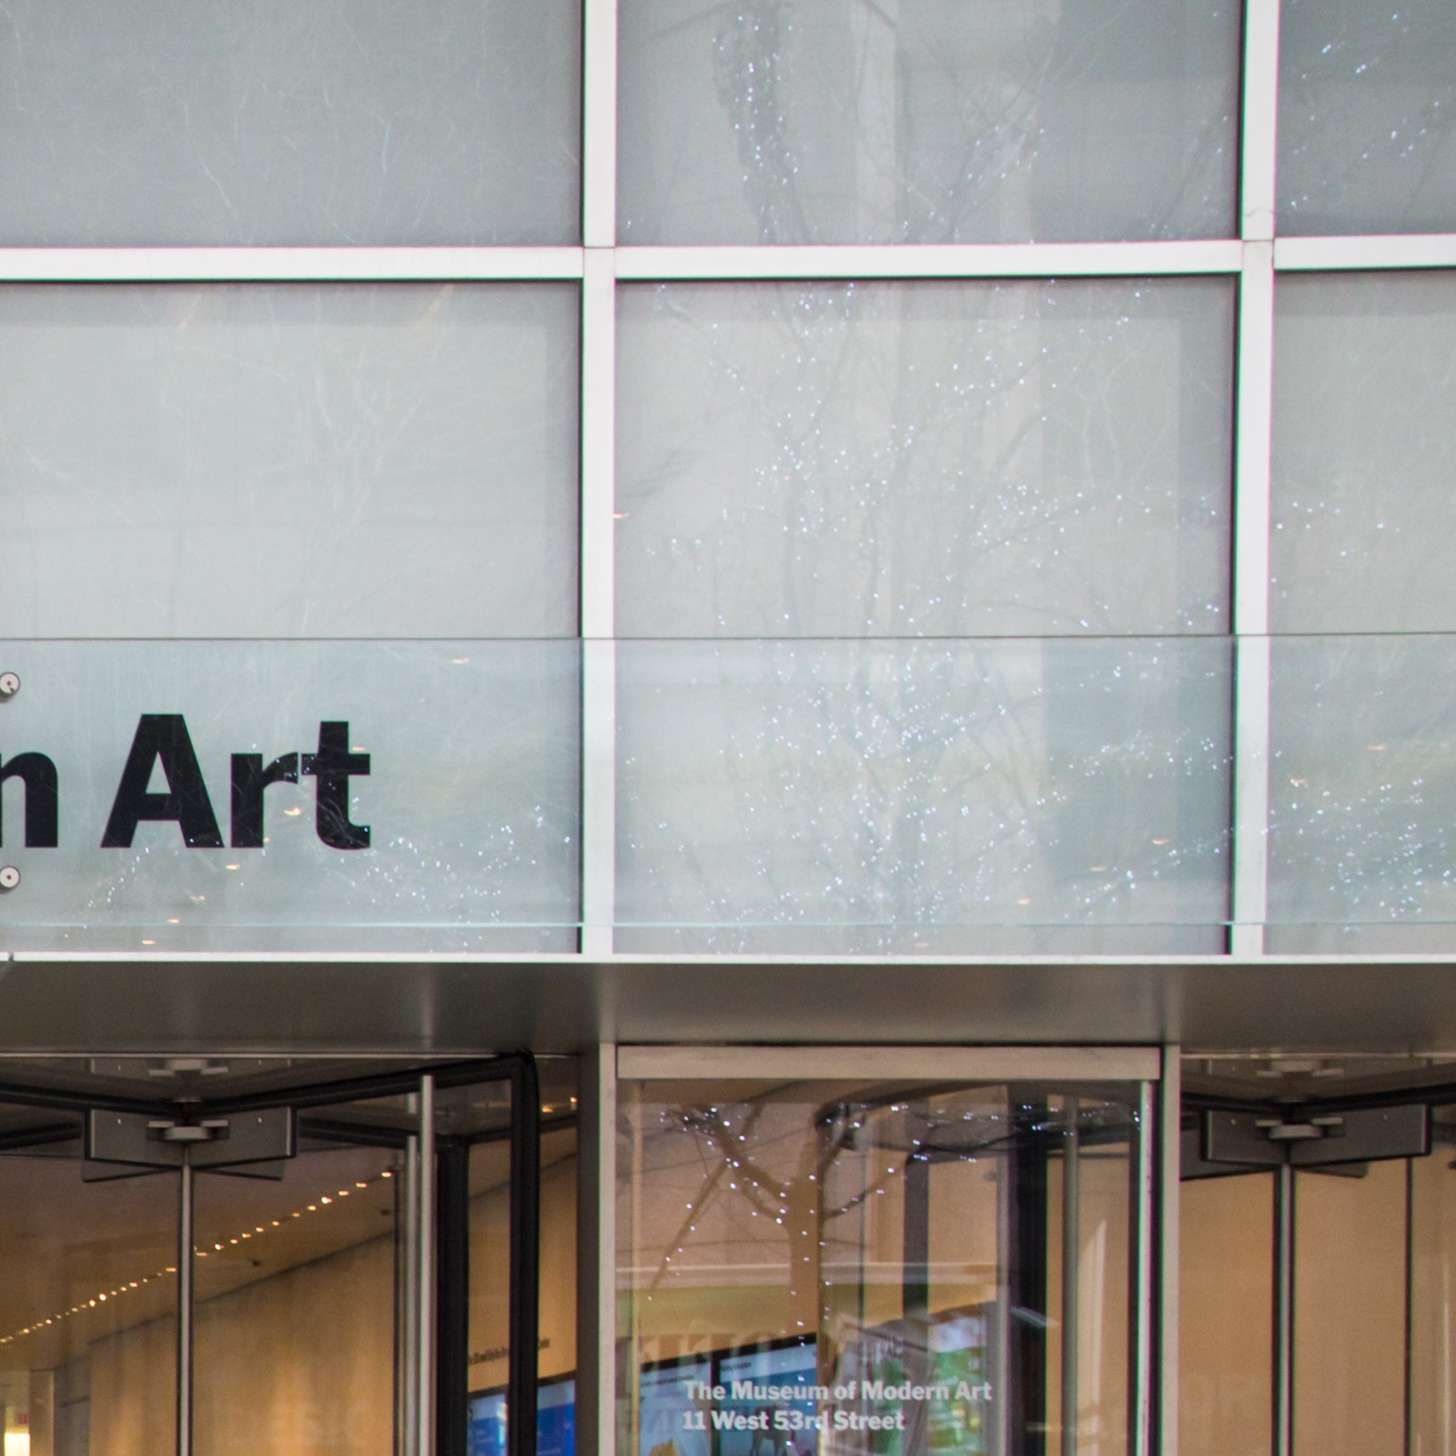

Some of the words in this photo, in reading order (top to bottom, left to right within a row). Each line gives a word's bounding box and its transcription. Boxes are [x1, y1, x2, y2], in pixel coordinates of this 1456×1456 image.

[100, 713, 372, 851] Art
[685, 1381, 726, 1400] The
[731, 1381, 829, 1401] Museum
[834, 1381, 857, 1400] of
[862, 1380, 949, 1400] Modern
[955, 1381, 992, 1400] Art
[682, 1411, 705, 1430] 11
[711, 1411, 769, 1430] West
[774, 1410, 829, 1430] 53rd
[834, 1410, 906, 1431] Street
